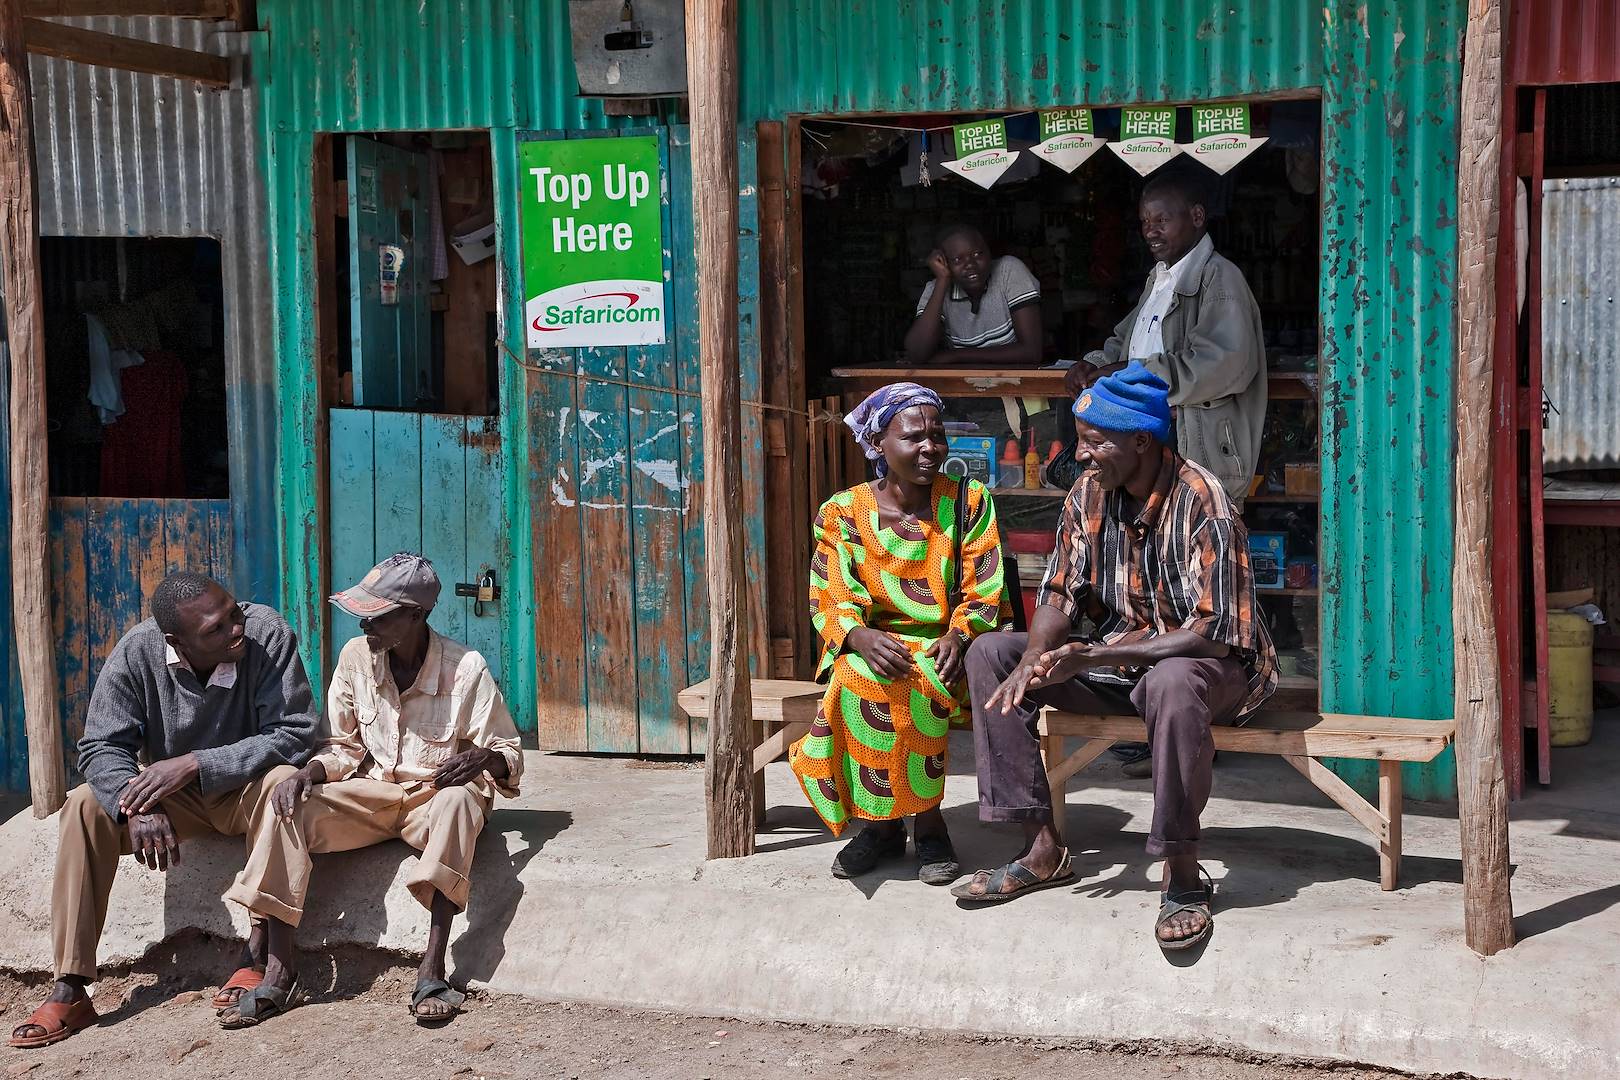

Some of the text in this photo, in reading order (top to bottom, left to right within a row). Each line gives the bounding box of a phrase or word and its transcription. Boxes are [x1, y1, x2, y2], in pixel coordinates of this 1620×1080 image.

[1043, 109, 1087, 121] TOP UP
[1126, 111, 1171, 121] TOP UP
[1196, 107, 1244, 119] TOP UP
[959, 123, 1001, 139] TOP UP
[1045, 118, 1089, 134] HERE
[1125, 121, 1171, 135] HERE
[1197, 117, 1245, 133] HERE
[961, 133, 1004, 151] HERE
[1048, 141, 1093, 151] Safaricom
[1126, 143, 1171, 153] Safaricom
[1200, 142, 1247, 151] Safaricom
[966, 156, 1008, 168] Safaricom
[529, 164, 650, 209] Top Up
[552, 217, 633, 253] Here
[545, 304, 661, 326] Safaricom
